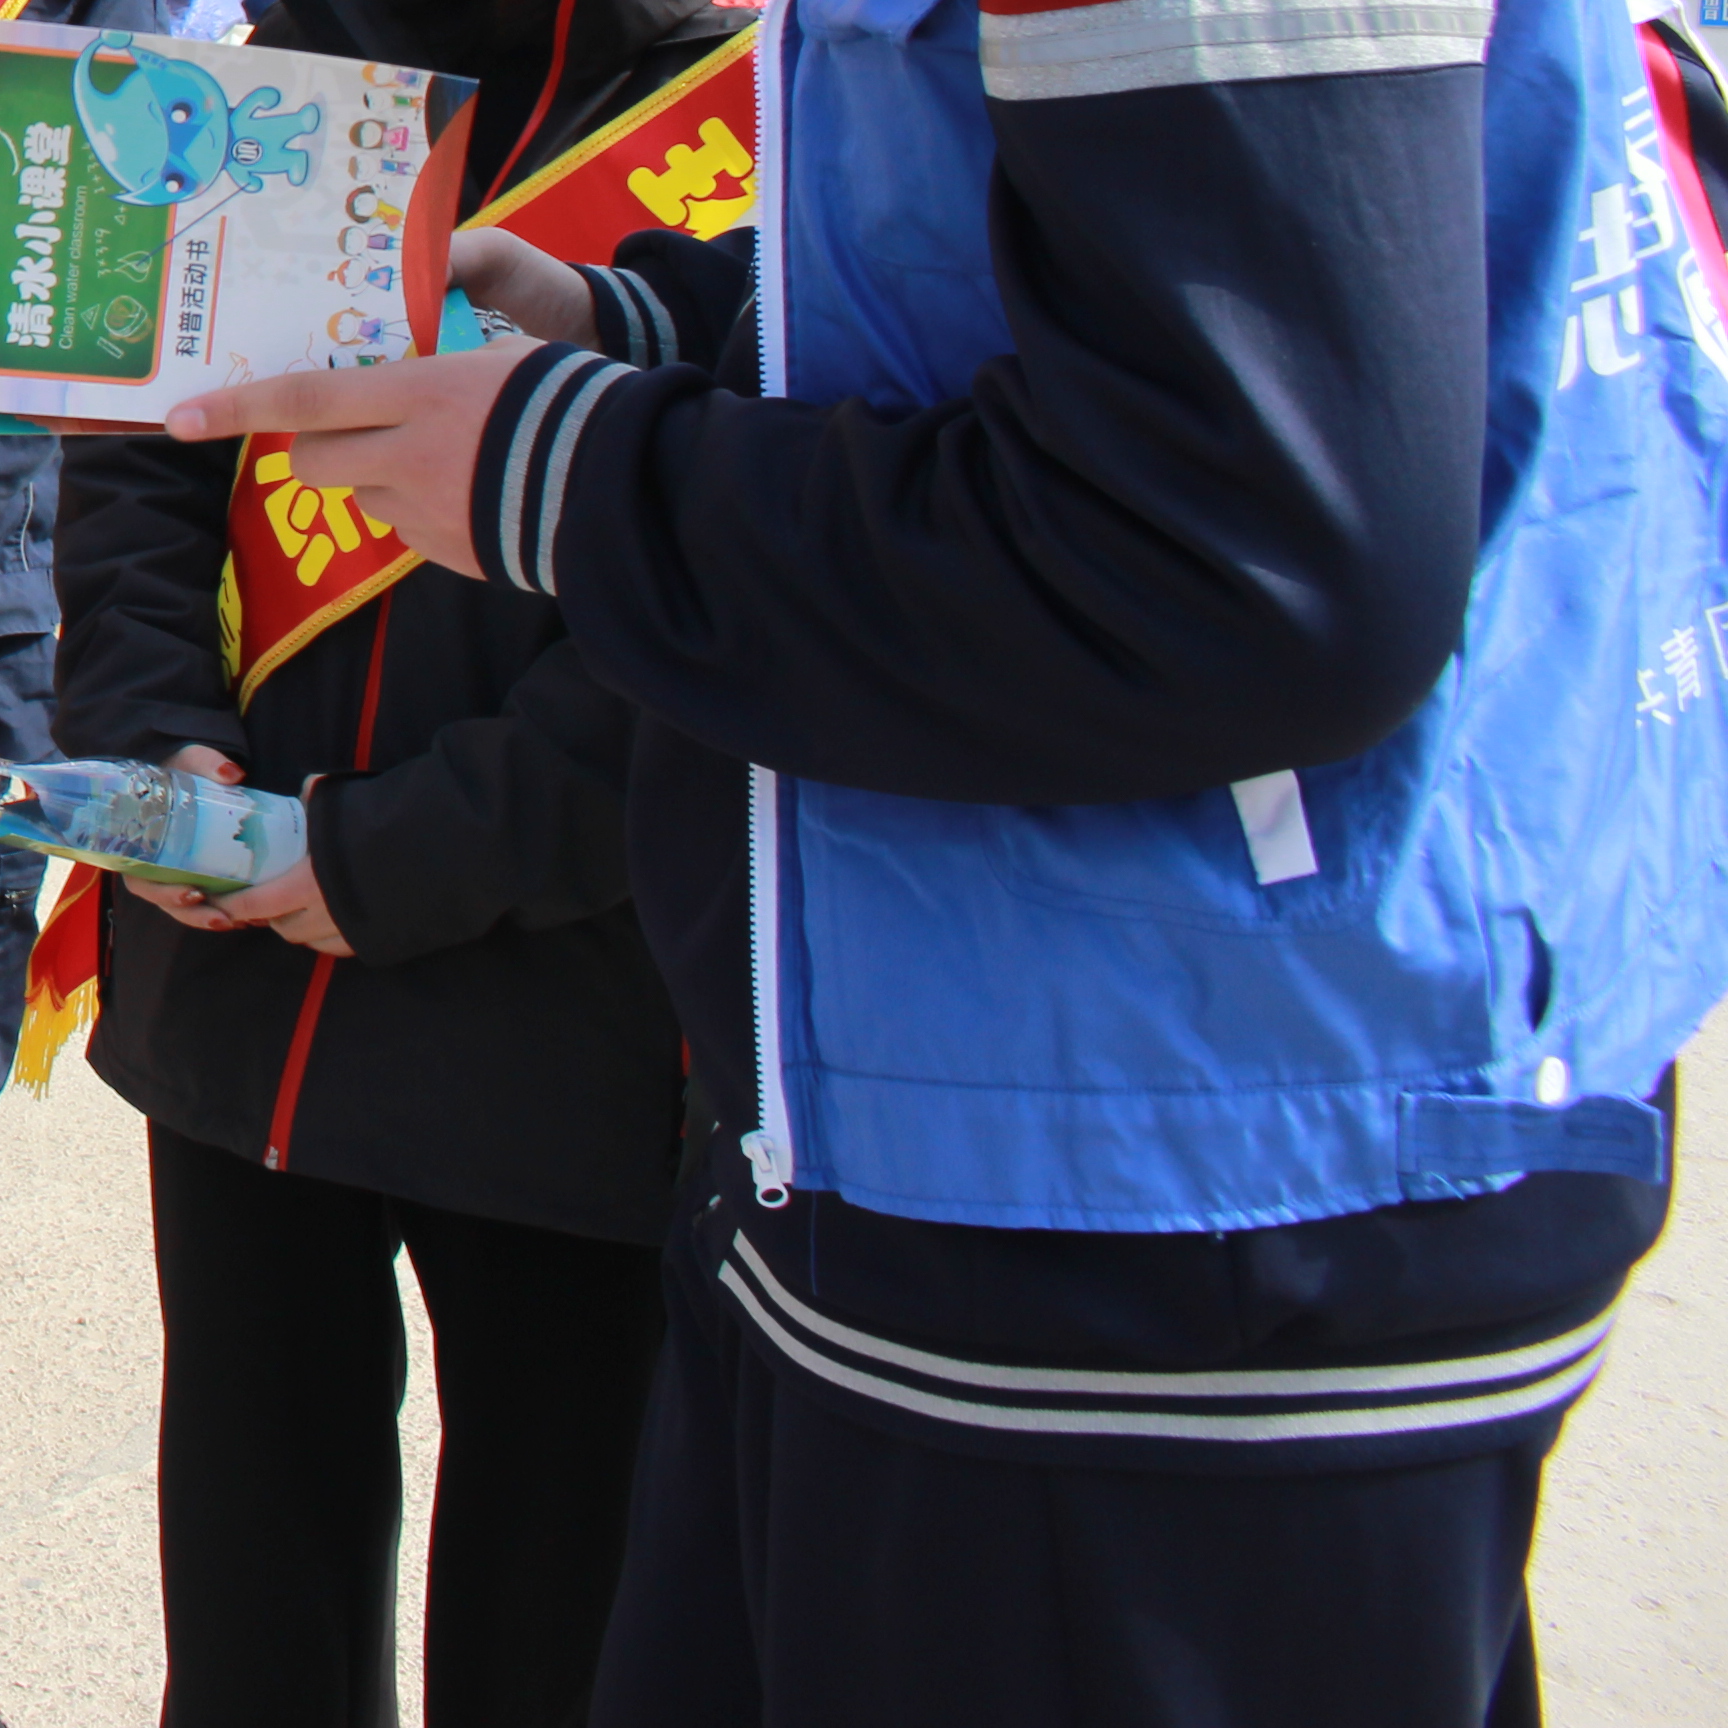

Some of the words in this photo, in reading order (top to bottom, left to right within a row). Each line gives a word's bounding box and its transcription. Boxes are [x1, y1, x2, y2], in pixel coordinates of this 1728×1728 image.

[6, 122, 72, 349] 清水小课堂
[68, 185, 88, 259] classroom
[65, 263, 79, 303] water
[175, 239, 209, 358] 科普活动书
[59, 307, 75, 350] Clean
